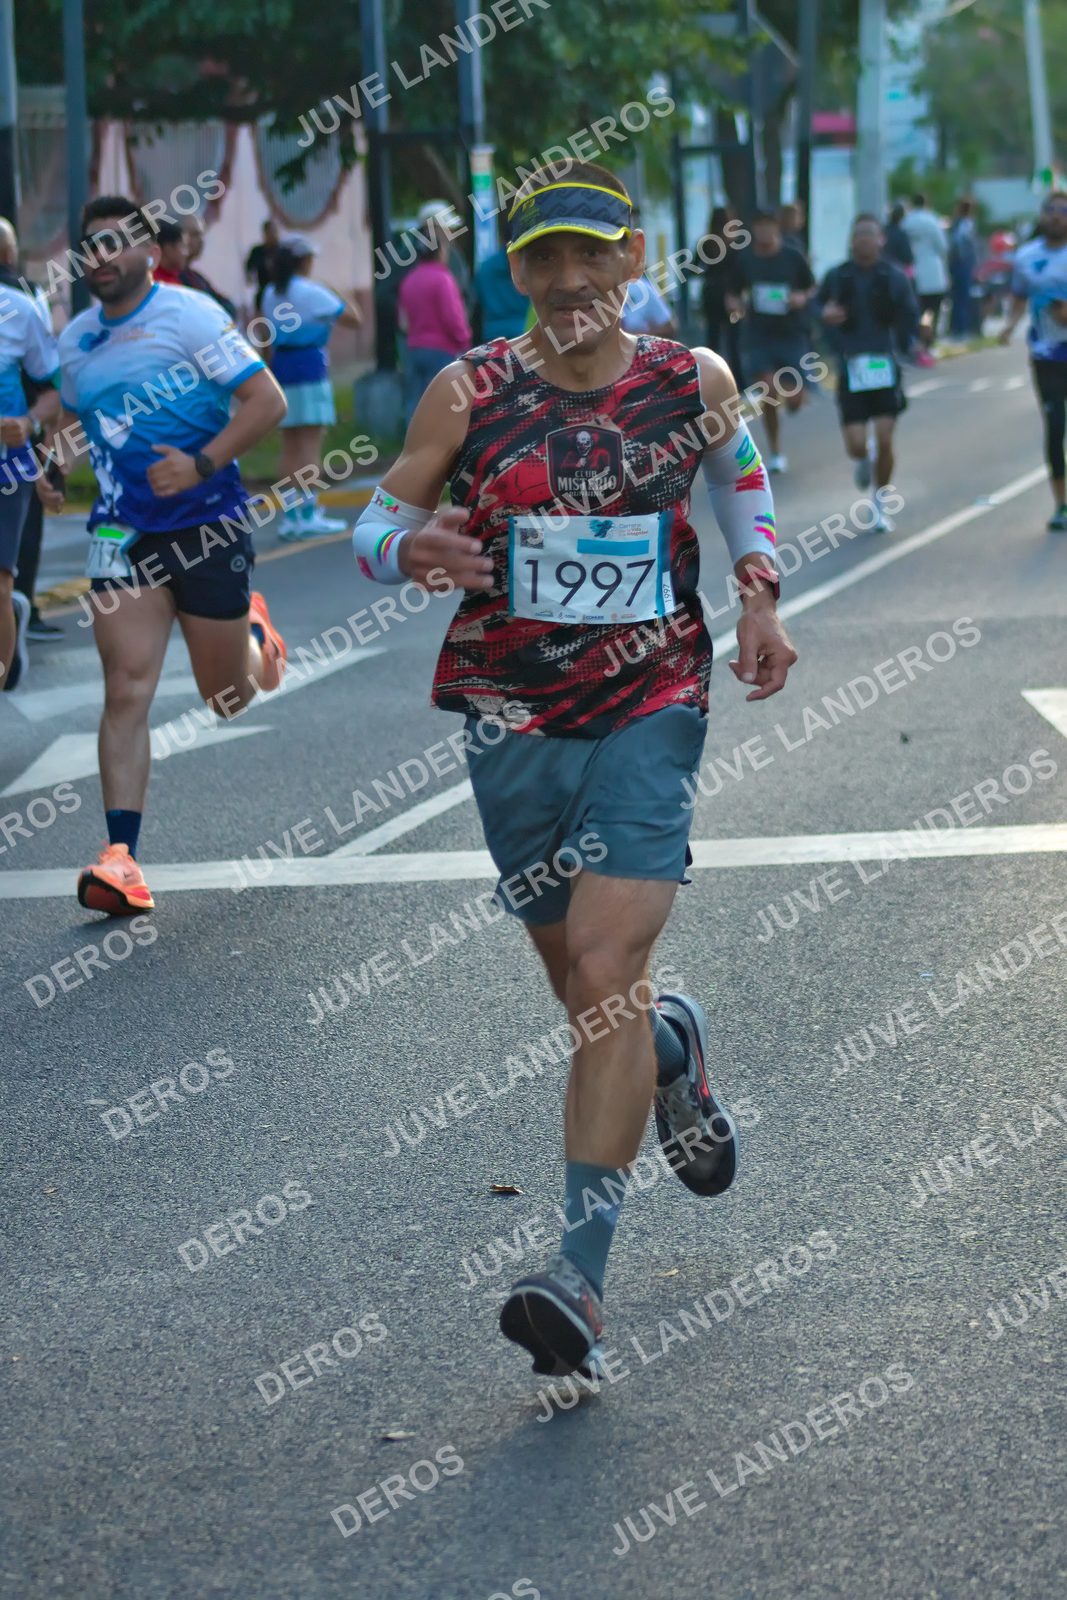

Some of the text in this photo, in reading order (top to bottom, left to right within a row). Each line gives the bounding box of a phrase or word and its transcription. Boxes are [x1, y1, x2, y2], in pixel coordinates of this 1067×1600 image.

[574, 470, 597, 478] CLUB
[524, 558, 656, 608] 1997
[662, 584, 672, 602] 1997
